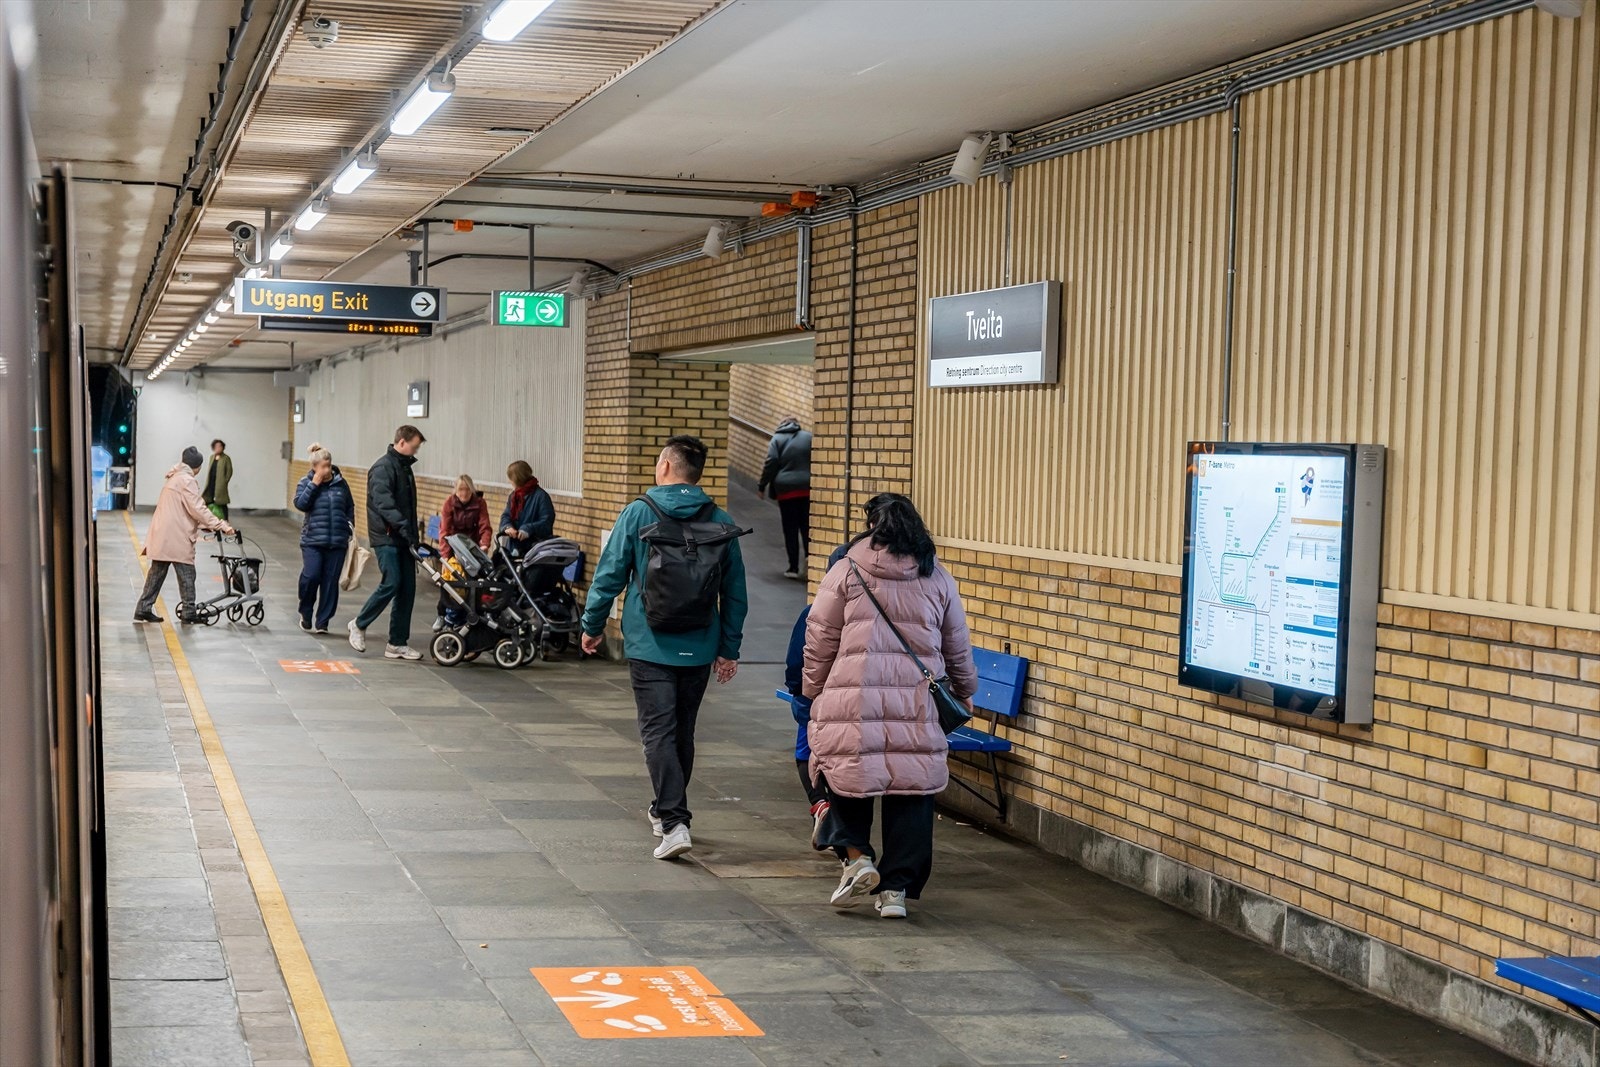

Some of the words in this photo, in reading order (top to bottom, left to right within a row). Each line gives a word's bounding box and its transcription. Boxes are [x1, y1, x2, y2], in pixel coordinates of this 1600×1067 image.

[250, 287, 325, 313] Utgang
[332, 291, 369, 311] Exit
[966, 308, 1003, 341] Tveita
[946, 367, 962, 379] Retning
[962, 367, 979, 376] sentrum
[980, 365, 999, 375] Direction
[1008, 364, 1022, 374] centre
[1208, 460, 1223, 469] T-bane
